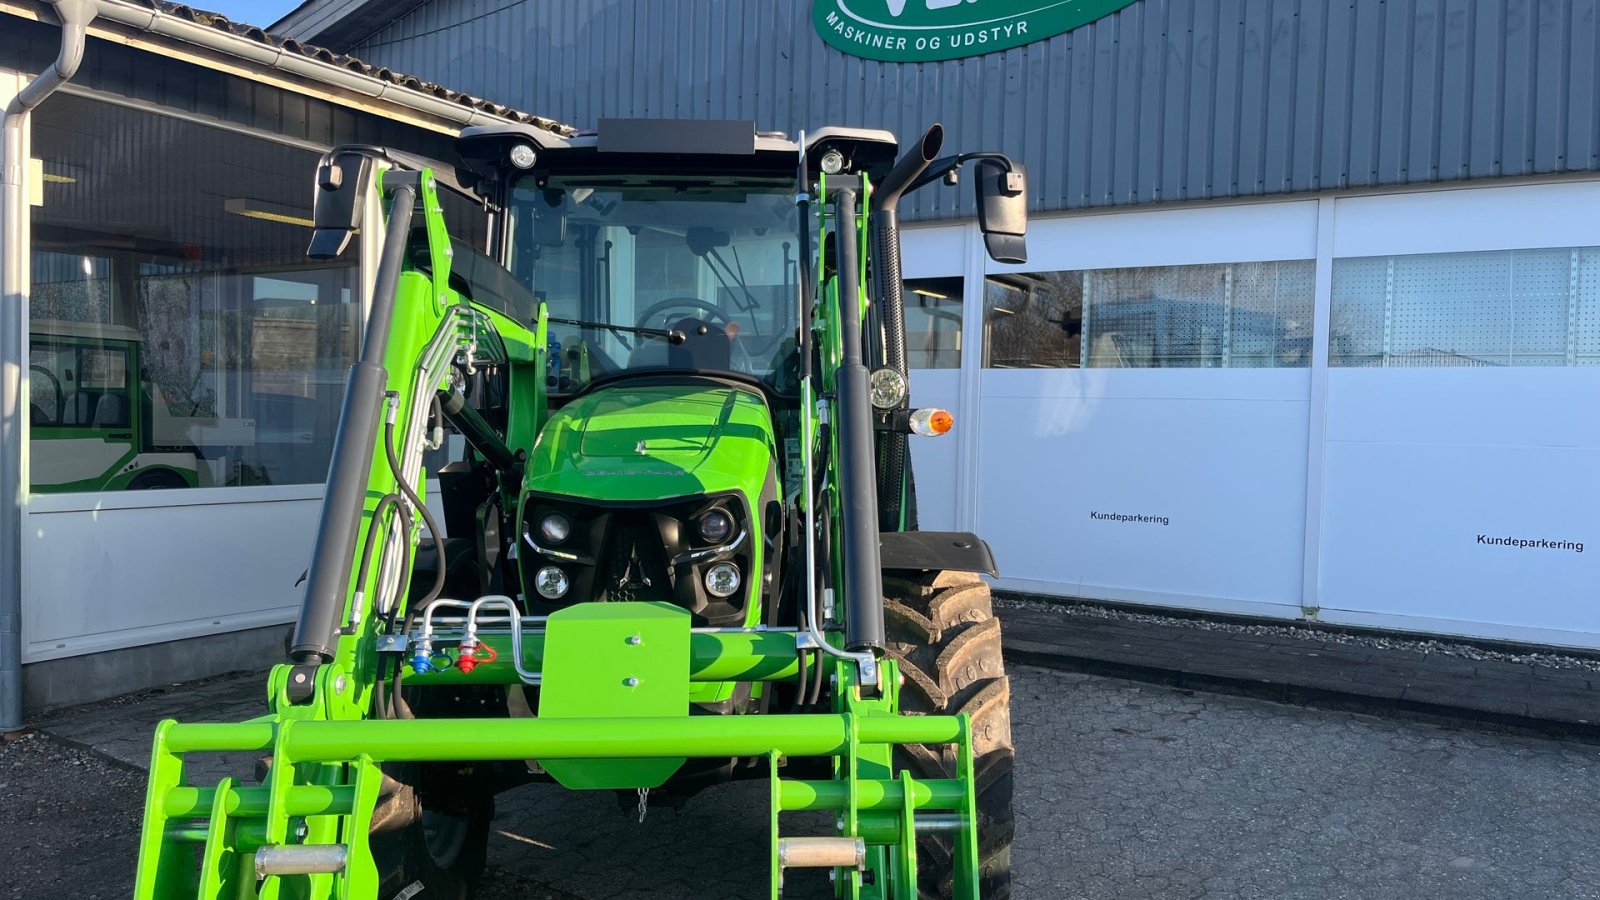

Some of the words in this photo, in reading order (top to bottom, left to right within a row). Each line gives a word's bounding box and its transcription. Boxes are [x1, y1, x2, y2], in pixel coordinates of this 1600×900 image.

[826, 11, 906, 50] MASKINER
[915, 37, 940, 50] OG
[950, 21, 1028, 47] UDSTYR
[1090, 511, 1169, 526] Kundeparkering
[1477, 534, 1584, 552] Kundeparkering
